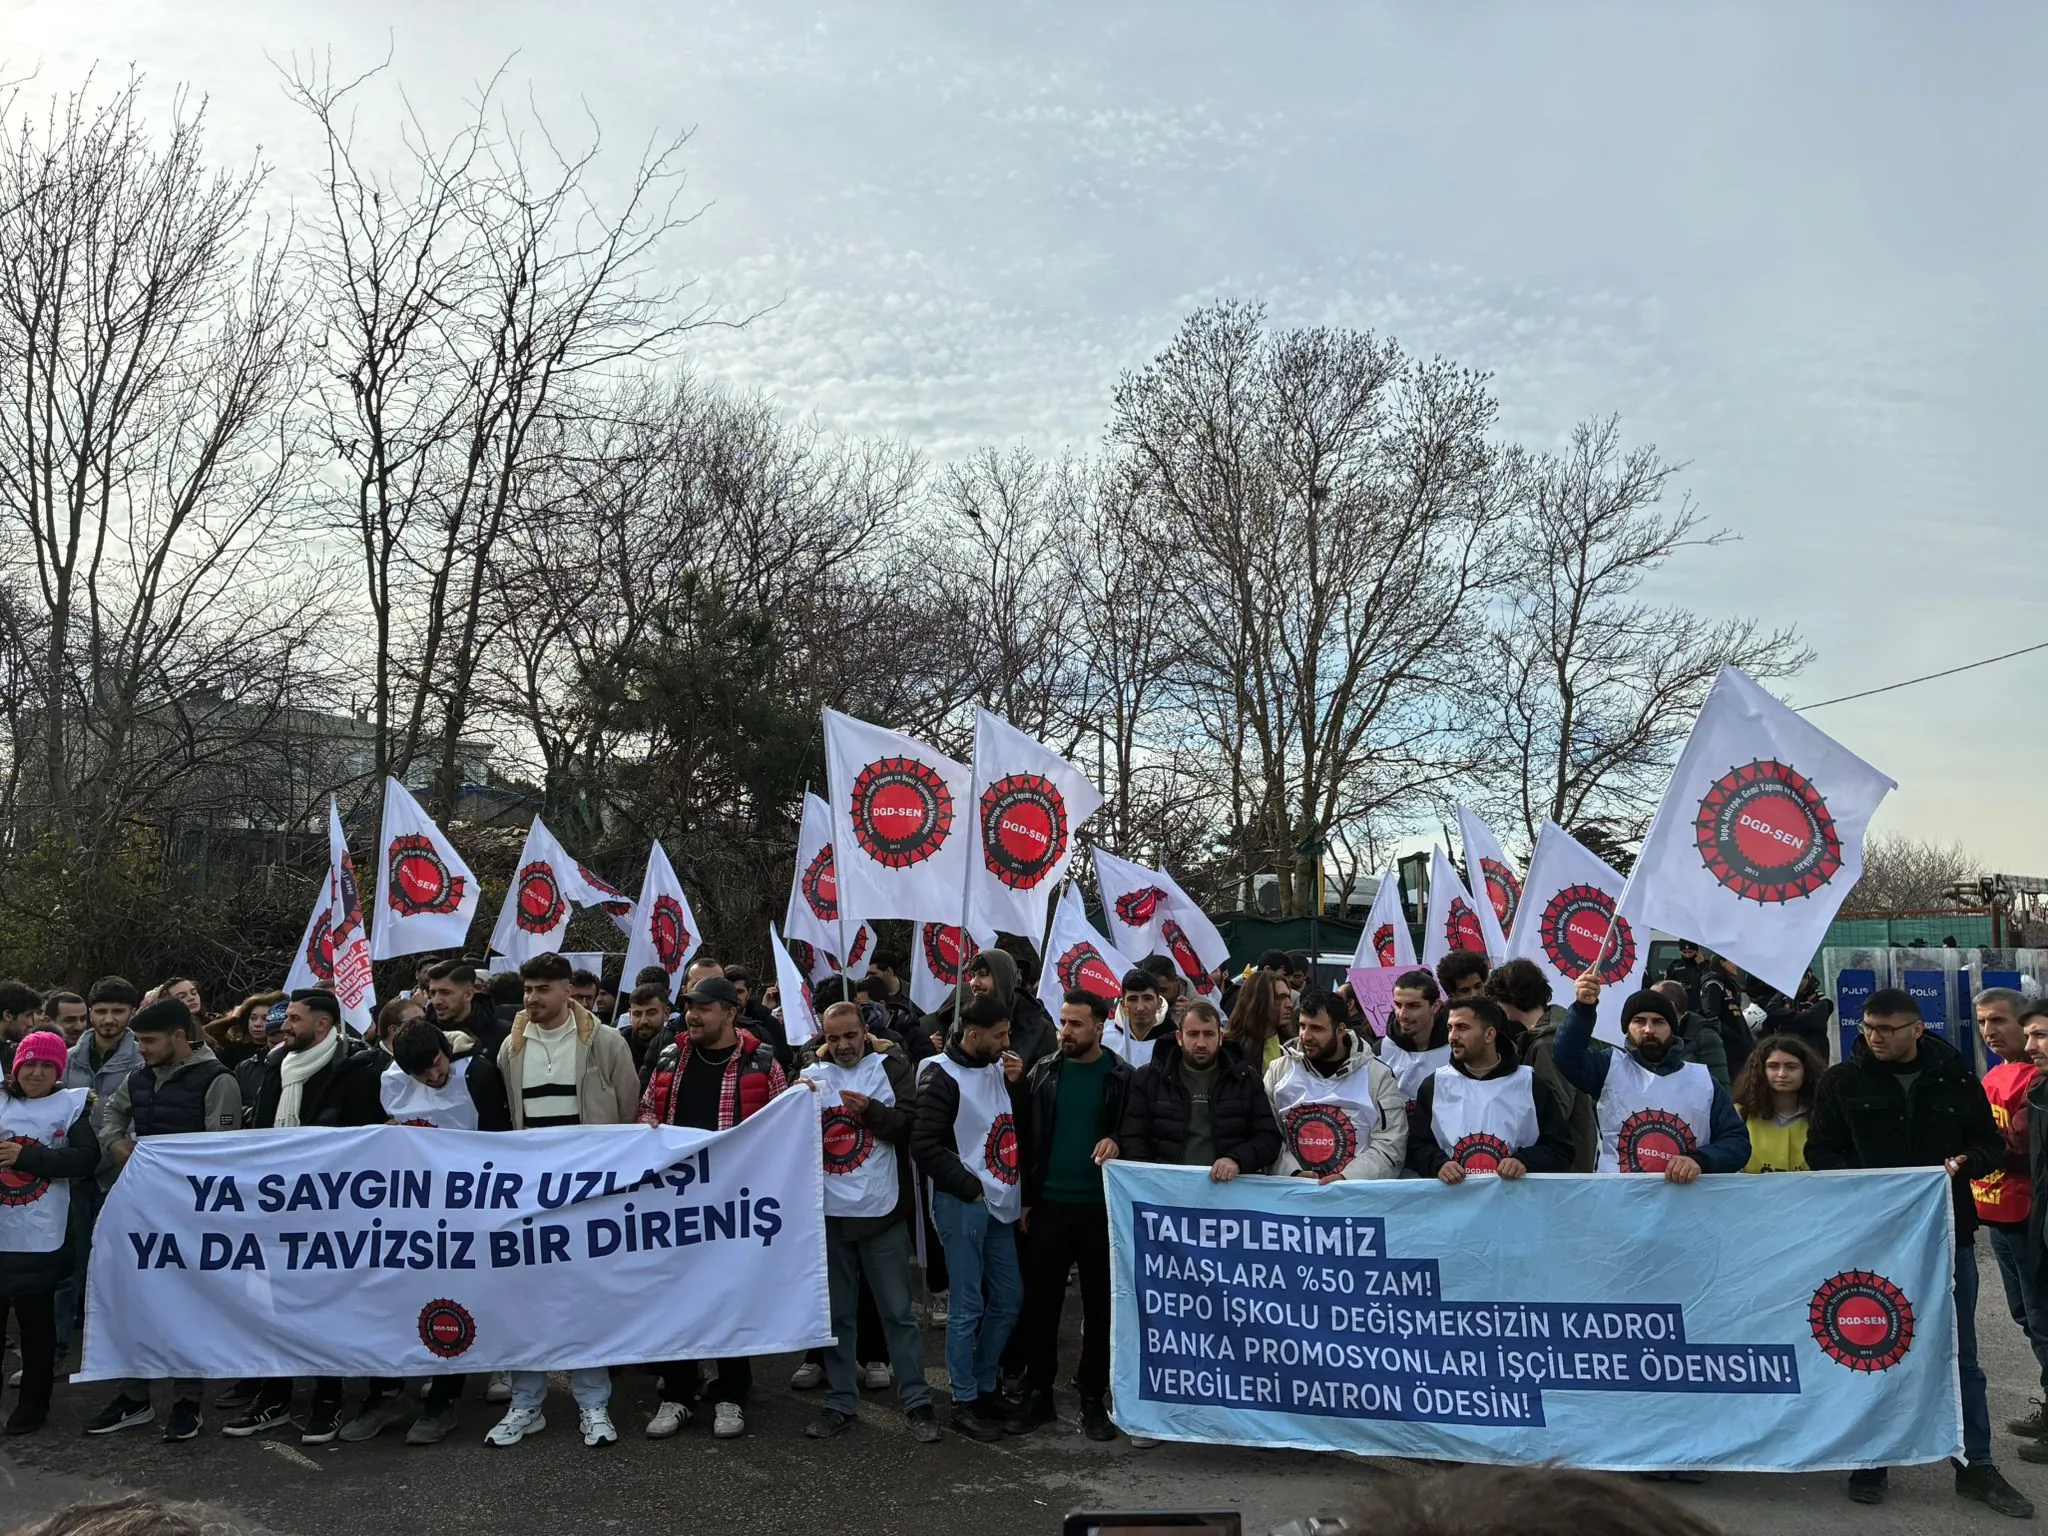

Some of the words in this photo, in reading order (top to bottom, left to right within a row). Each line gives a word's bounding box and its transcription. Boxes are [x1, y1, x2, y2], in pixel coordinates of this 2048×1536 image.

[873, 807, 922, 817] DGD-SEN
[1741, 784, 1760, 798] Gemi
[1760, 783, 1783, 792] Yapımı
[1002, 820, 1048, 844] DGD-SEN
[1740, 814, 1804, 849] DGD-SEN
[1637, 1148, 1672, 1160] DGD-SE
[186, 1175, 245, 1212] YA
[258, 1170, 431, 1213] SAYGIN
[444, 1161, 524, 1210] BİR
[537, 1147, 710, 1210] UZLAŞI
[128, 1232, 187, 1270] YA
[199, 1232, 266, 1270] DA
[279, 1218, 476, 1270] TAVİZSİZ
[489, 1217, 572, 1268] BİR
[586, 1187, 782, 1260] DİRENİŞ
[1141, 1211, 1376, 1257] TALEPLERİMİZ
[1145, 1254, 1286, 1290] MAAŞLARA
[1297, 1265, 1354, 1294] %50
[1364, 1270, 1432, 1297] ZAM!
[1146, 1290, 1213, 1320] DEPO
[1223, 1290, 1319, 1330] İŞKOLU
[1331, 1302, 1550, 1339] DEĞİŞMEKSİZİN
[1562, 1311, 1676, 1340] KADRO!
[1838, 1316, 1887, 1325] DGD-SEN
[1148, 1328, 1236, 1360] BANKA
[1245, 1336, 1487, 1376] PROMOSYONLARI
[1498, 1344, 1630, 1384] İŞÇİLERE
[1640, 1348, 1793, 1384] ÖDENSİN!
[1149, 1366, 1281, 1402] VERGİLERİ
[1292, 1380, 1402, 1412] PATRON
[1413, 1381, 1531, 1418] ÖDESİN!
